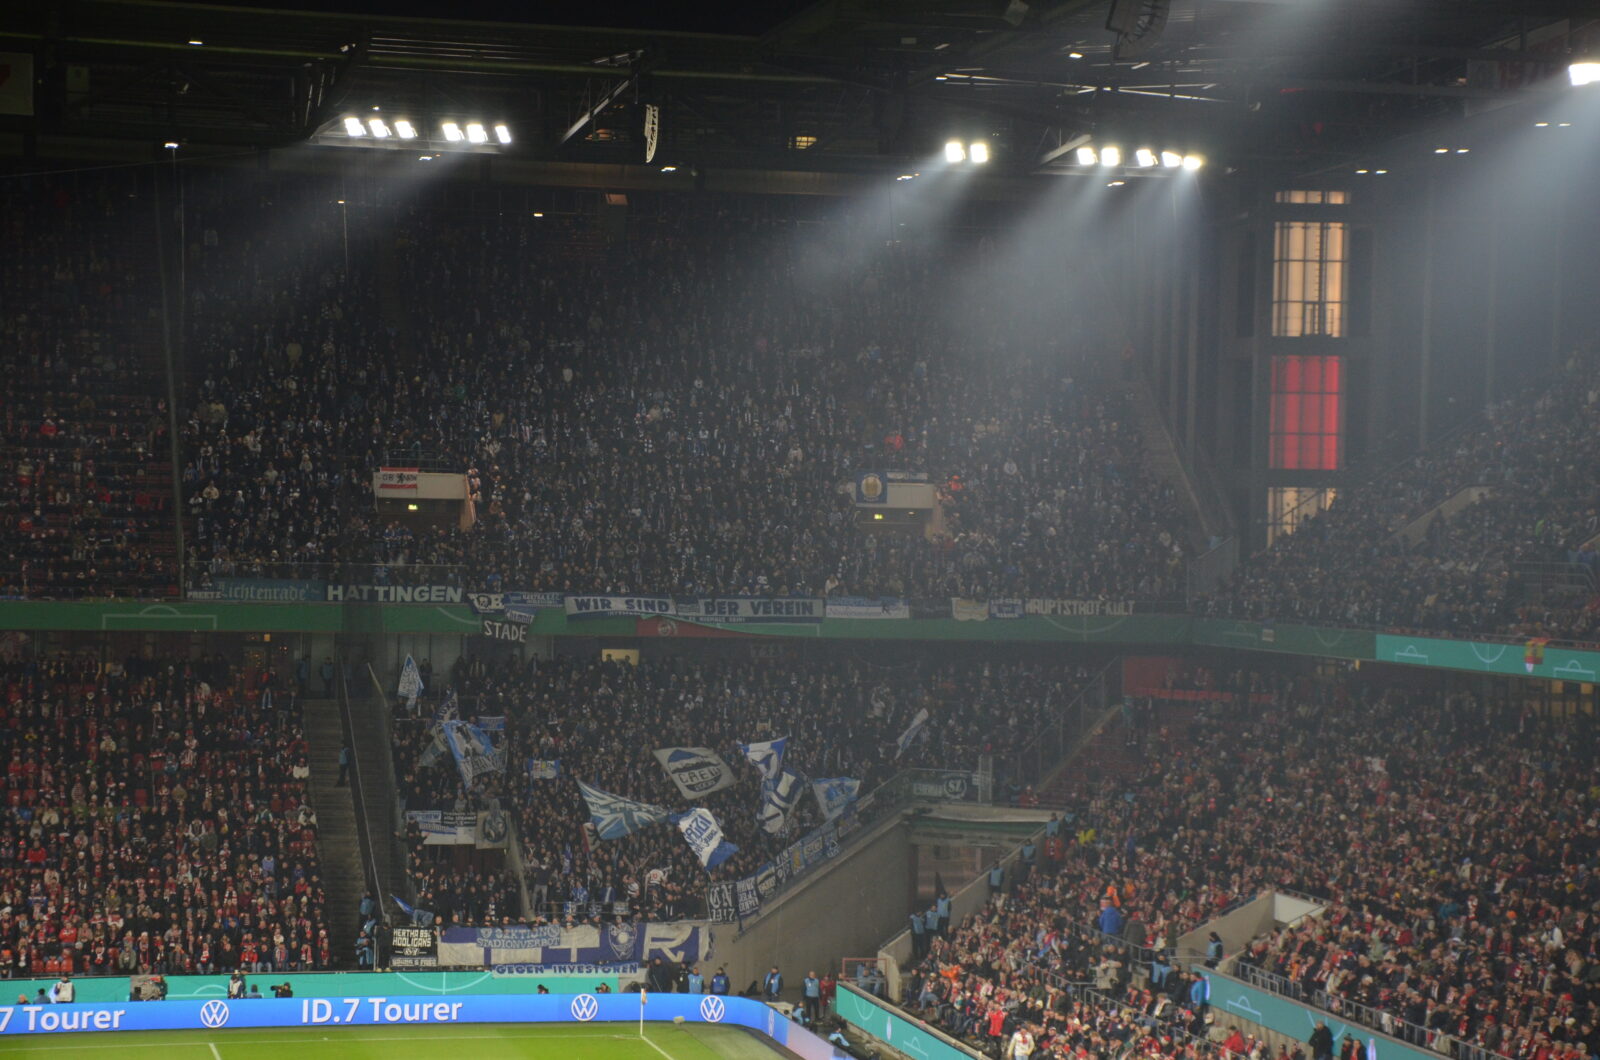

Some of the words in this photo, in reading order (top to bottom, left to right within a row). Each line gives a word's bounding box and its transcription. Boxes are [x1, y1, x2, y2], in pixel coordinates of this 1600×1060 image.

[574, 598, 612, 611] WIR
[625, 599, 670, 612] SIND
[704, 600, 740, 615] DER
[750, 600, 814, 615] VEREIN
[484, 619, 528, 643] STADE
[393, 928, 419, 937] HERTHA
[392, 937, 432, 948] HOOLIGANS
[476, 936, 560, 949] STADIONVERBOT
[495, 965, 545, 974] GEGEN
[552, 963, 639, 974] INVESTOREN
[302, 998, 360, 1023] ID.7
[368, 997, 463, 1022] Tourer
[23, 1006, 125, 1031] Tourer
